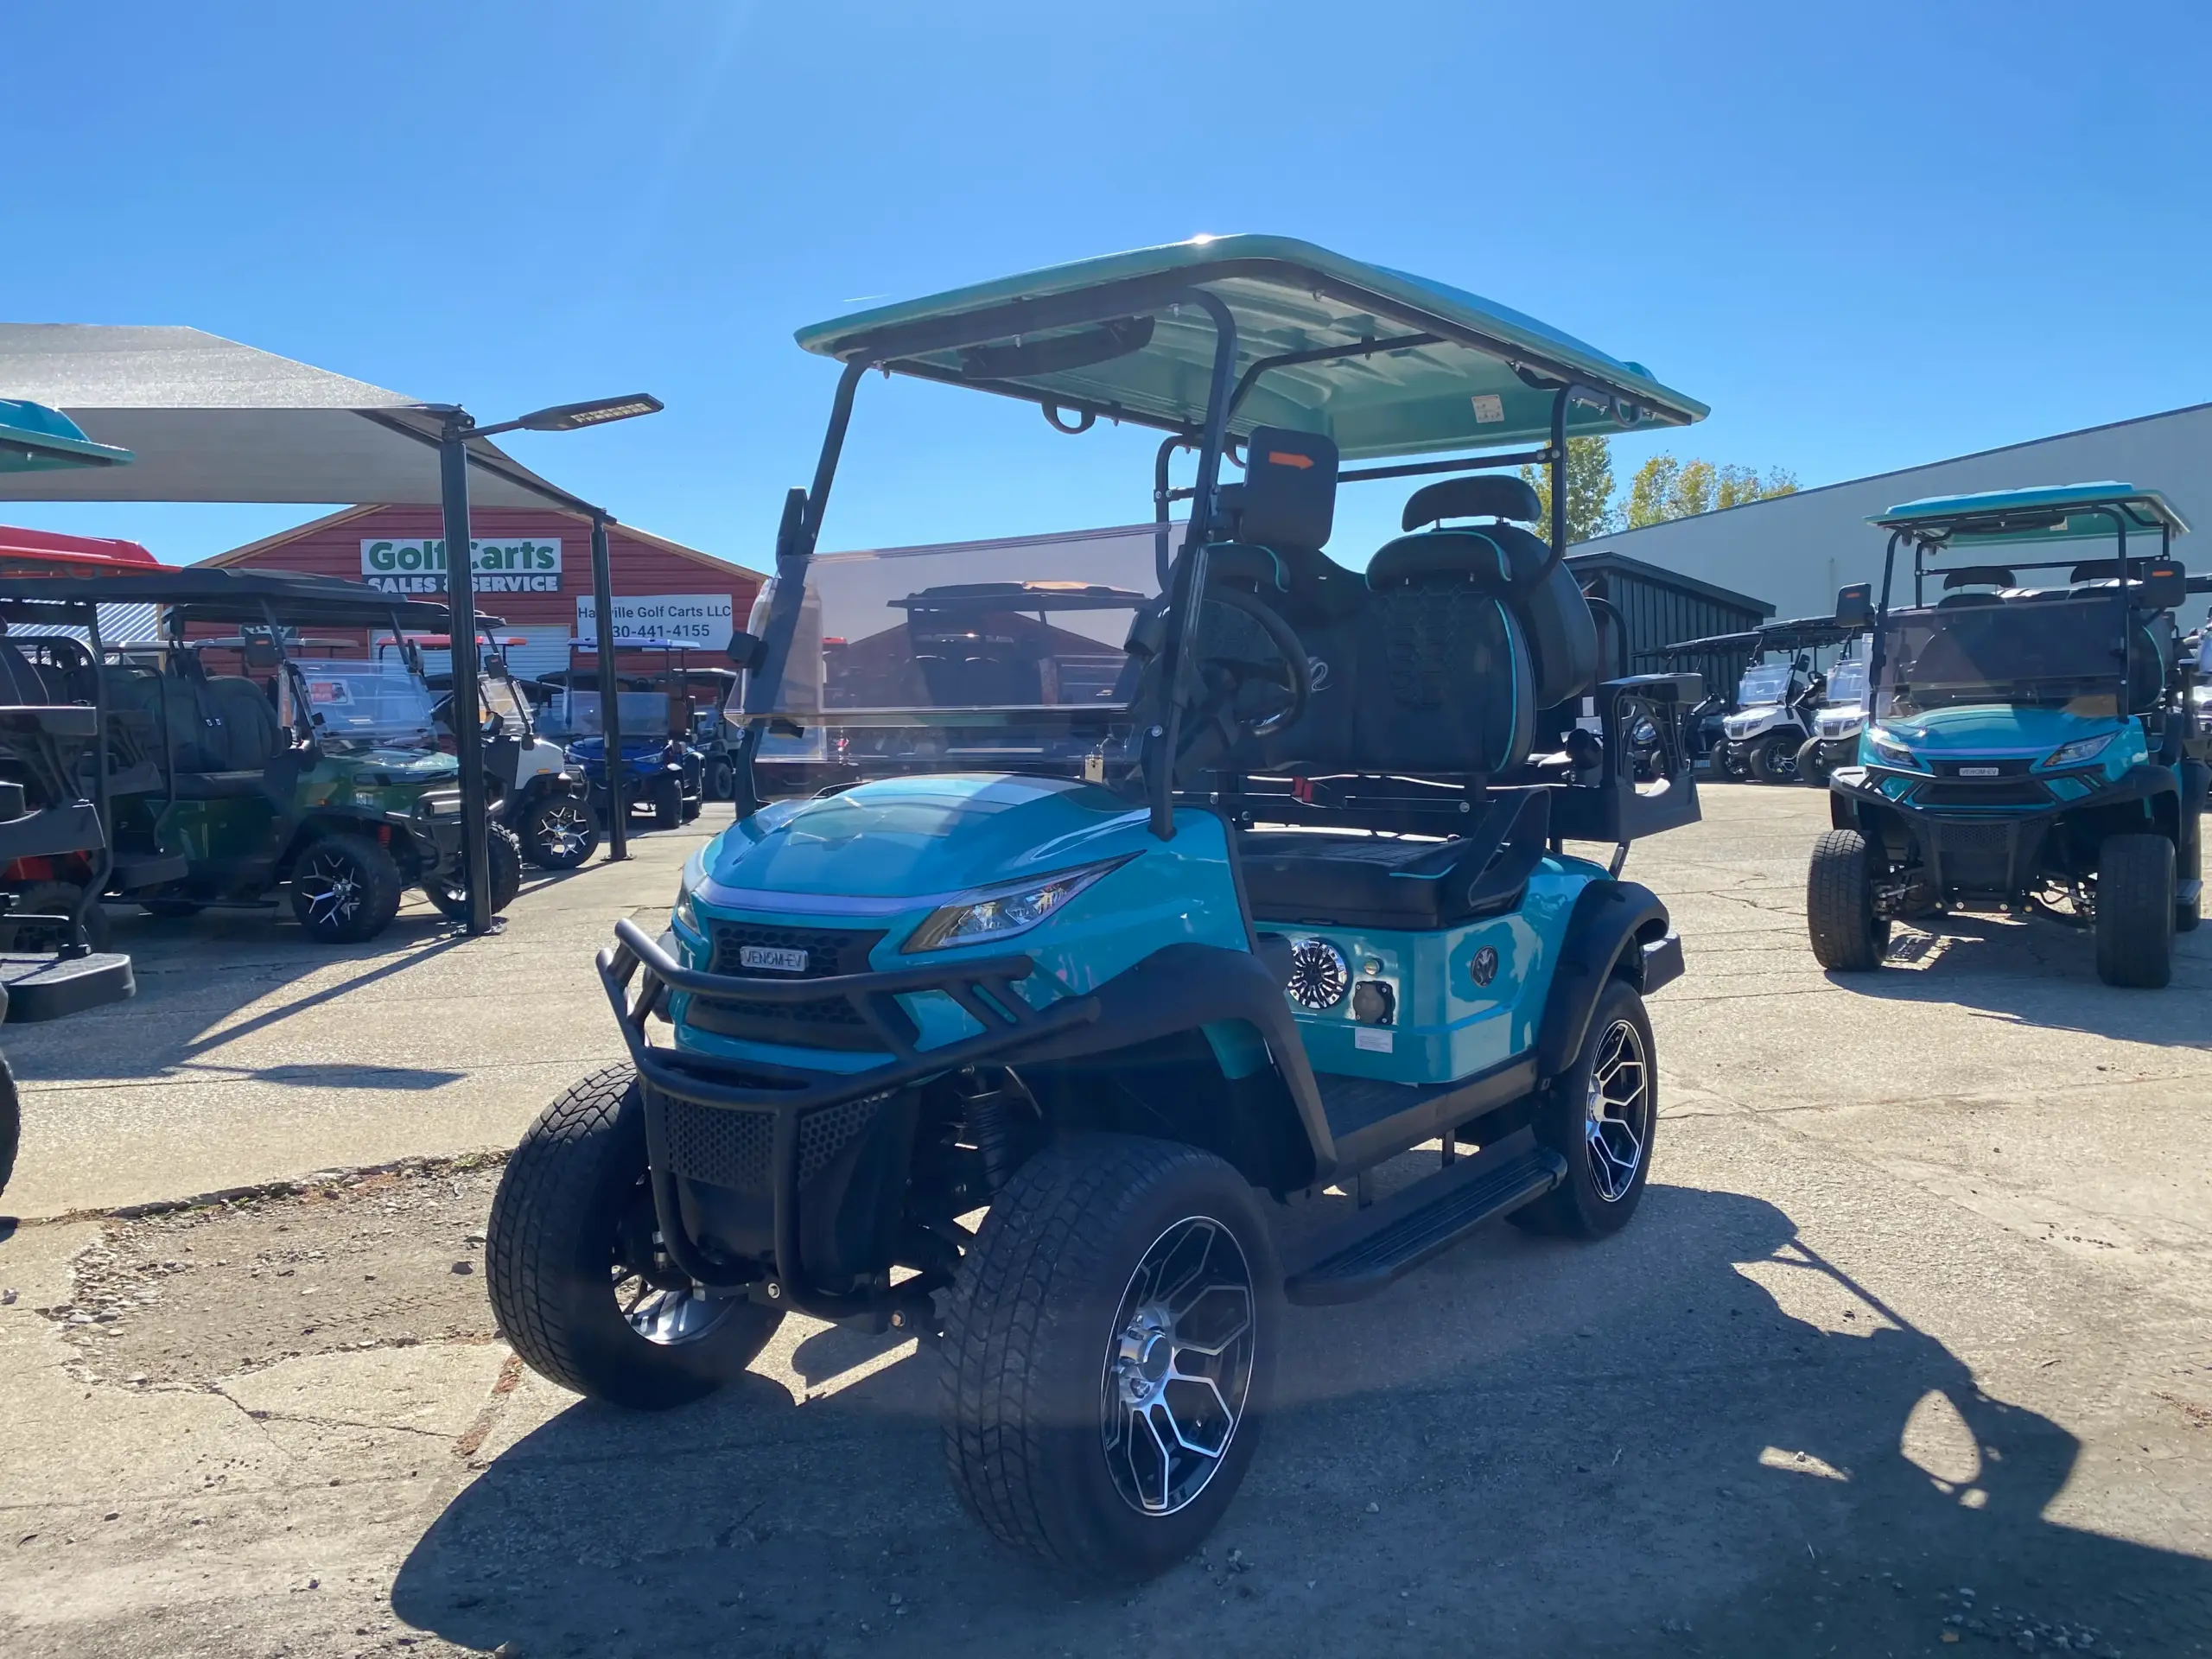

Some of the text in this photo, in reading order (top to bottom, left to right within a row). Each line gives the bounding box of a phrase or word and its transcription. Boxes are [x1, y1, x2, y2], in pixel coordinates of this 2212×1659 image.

[368, 577, 437, 593] SALES
[638, 607, 664, 618] Golf
[668, 606, 703, 617] Carts
[707, 606, 731, 617] LLC
[746, 950, 802, 967] VENOM-EV
